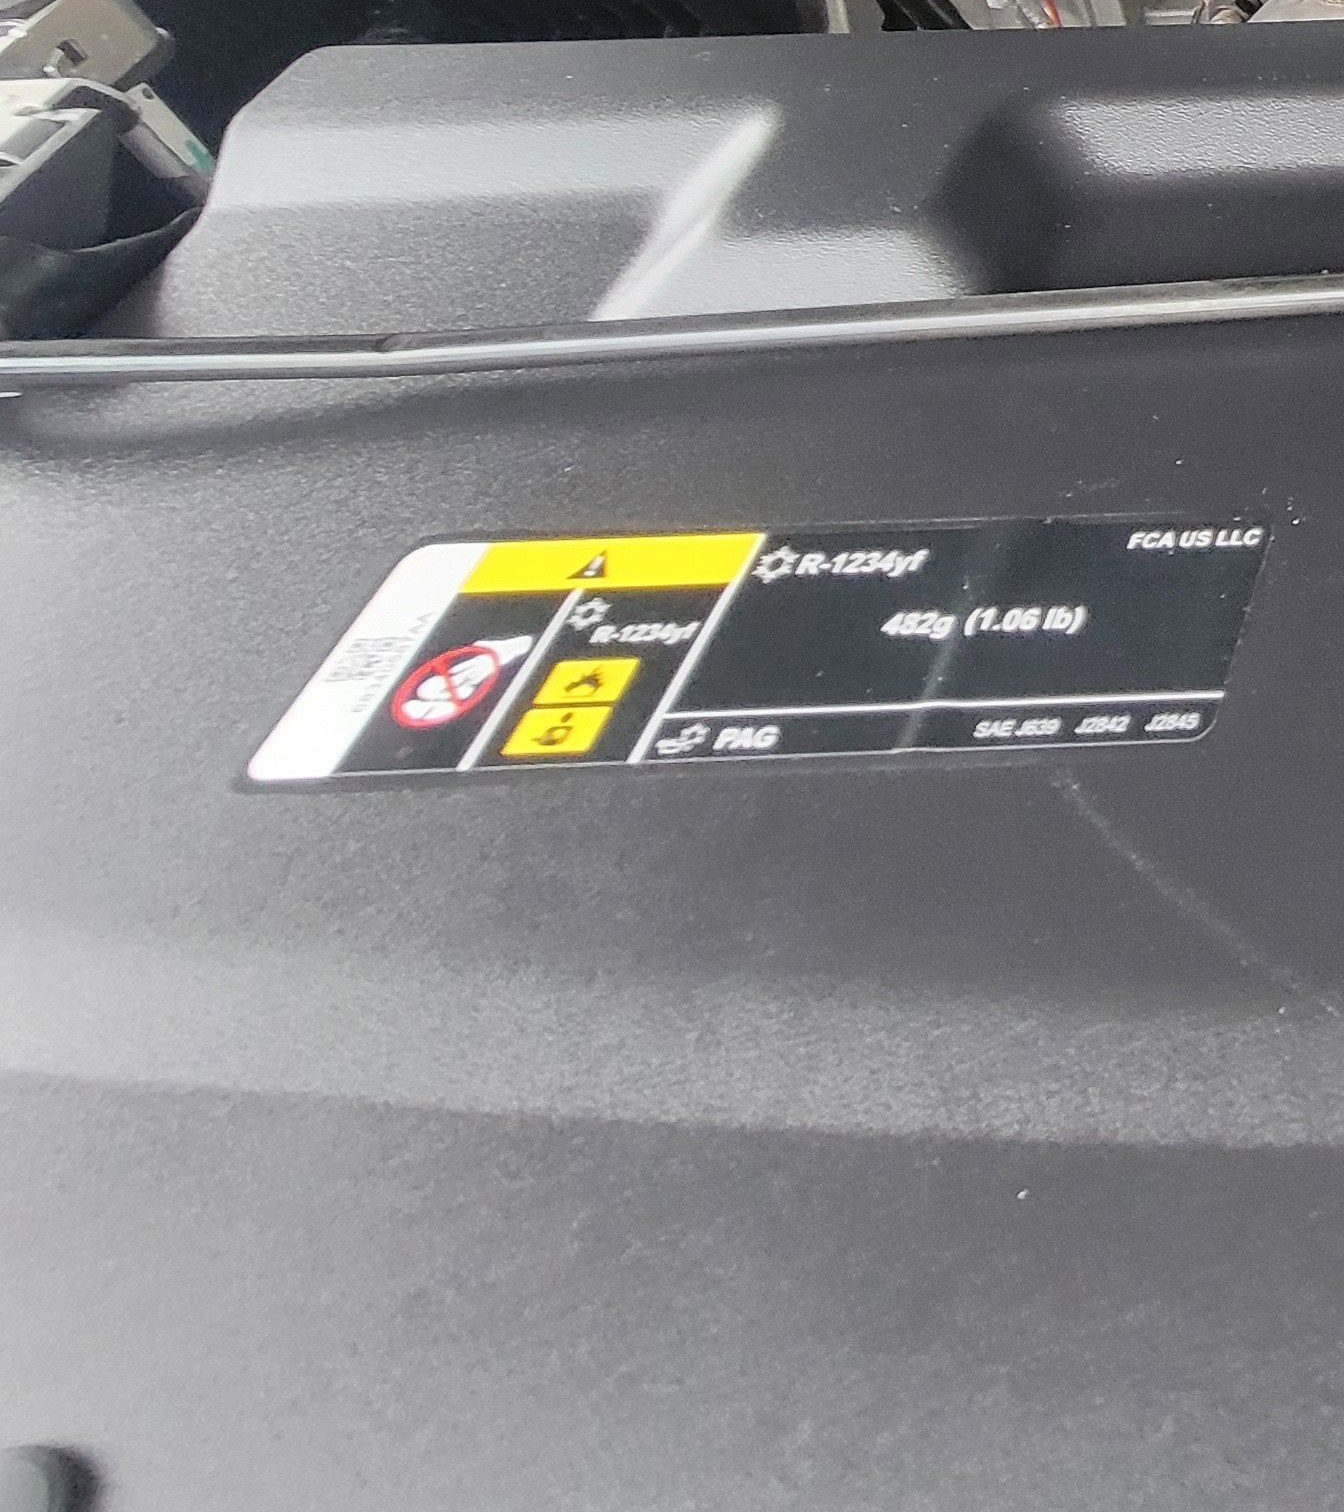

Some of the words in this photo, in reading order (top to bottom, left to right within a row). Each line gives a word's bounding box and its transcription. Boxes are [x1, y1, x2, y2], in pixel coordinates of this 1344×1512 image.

[1126, 529, 1174, 550] FCA
[1178, 529, 1213, 548] US
[1214, 527, 1263, 547] LLC
[794, 547, 930, 578] R-1234yf
[879, 609, 958, 640] 482g
[963, 606, 1041, 637] (1.06
[1042, 604, 1087, 635] lb)
[712, 724, 782, 751] PAG
[972, 718, 1016, 738] SAE
